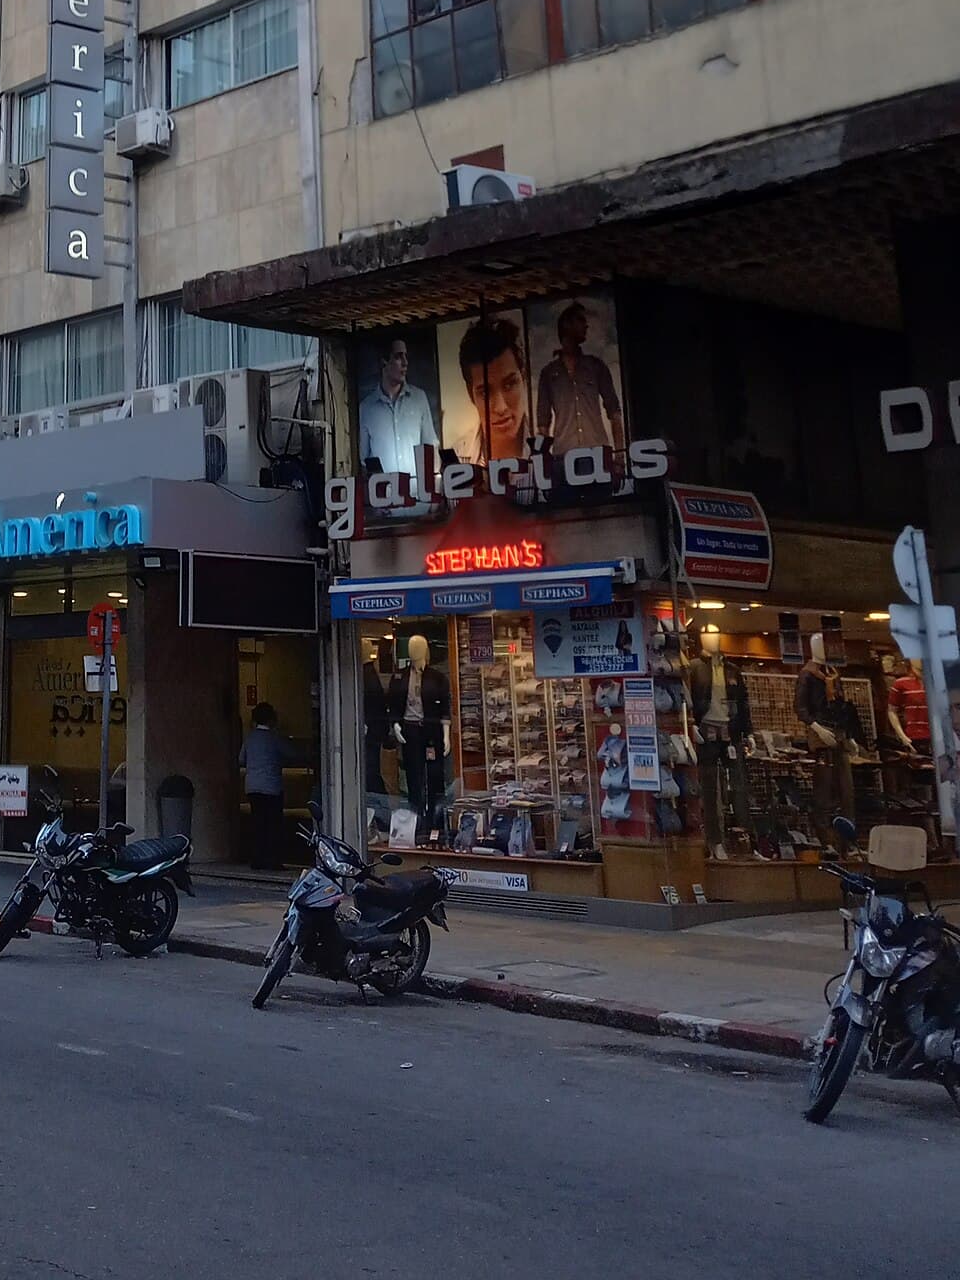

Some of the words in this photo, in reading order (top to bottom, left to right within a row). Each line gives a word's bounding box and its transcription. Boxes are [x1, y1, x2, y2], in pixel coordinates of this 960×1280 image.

[437, 592, 488, 605] STEPHANS
[526, 587, 584, 599] STEPHANS
[355, 597, 401, 609] STEPHANS
[505, 876, 526, 888] VISA
